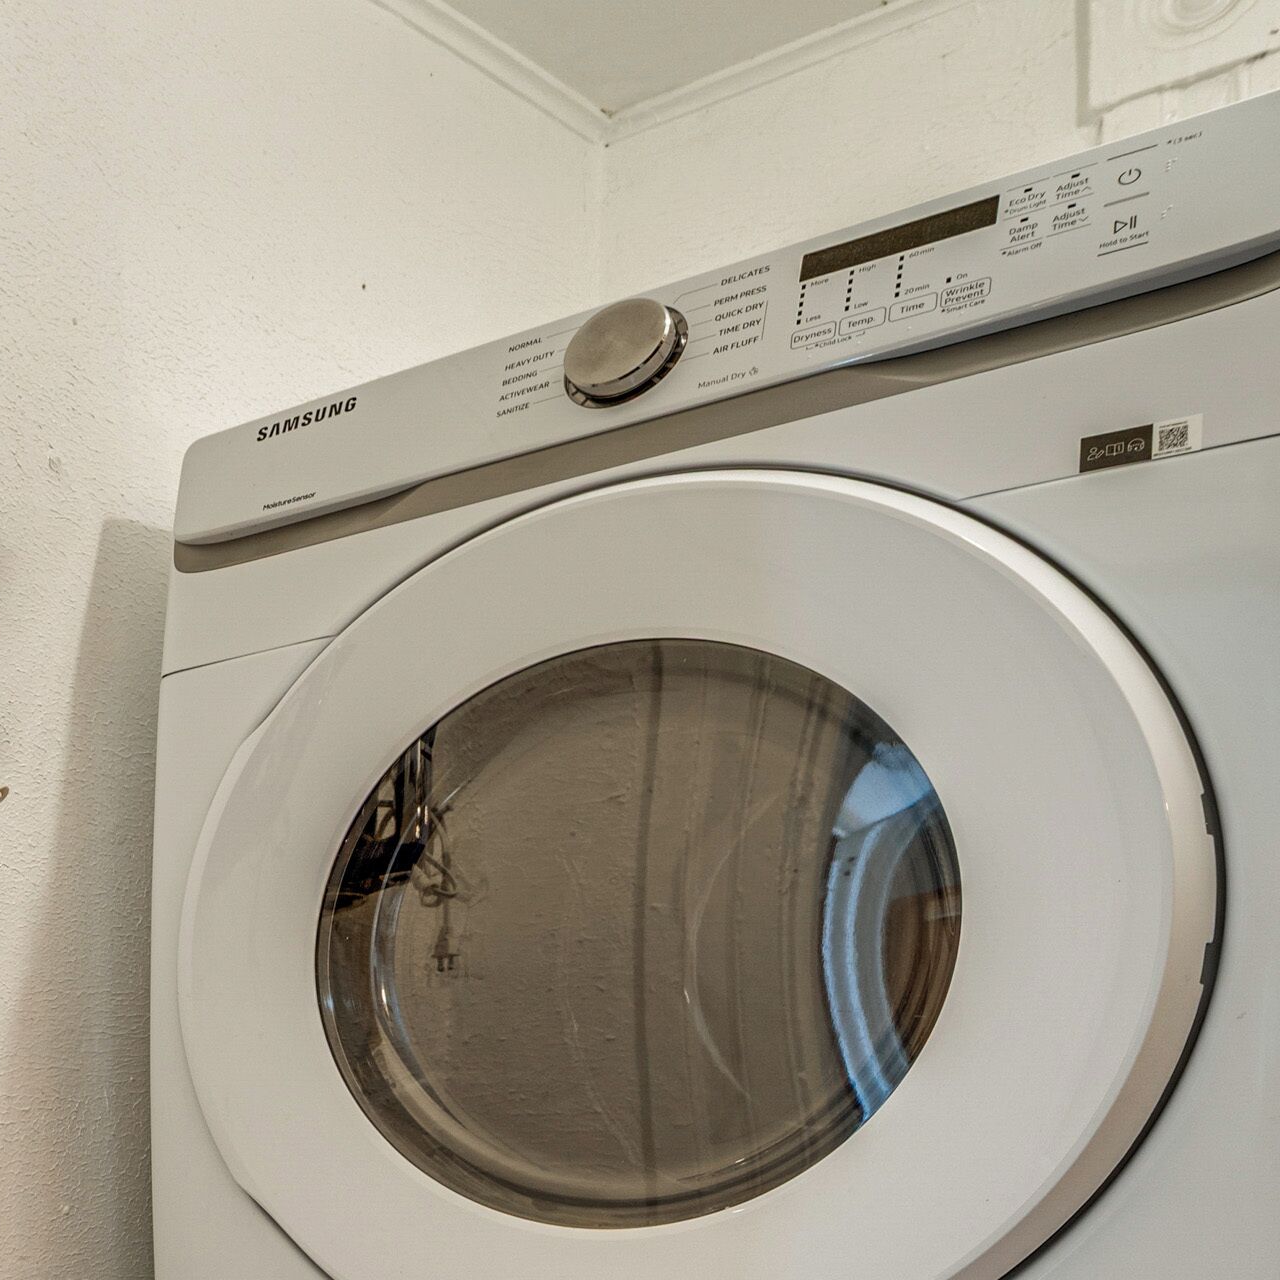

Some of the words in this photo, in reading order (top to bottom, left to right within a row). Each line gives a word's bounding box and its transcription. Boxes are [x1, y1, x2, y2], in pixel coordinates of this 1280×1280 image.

[1056, 177, 1089, 193] Adjust
[1009, 196, 1026, 206] Eco
[1027, 190, 1046, 203] Dry
[1056, 189, 1080, 200] Time
[1052, 208, 1085, 224] Adjust
[1009, 222, 1038, 236] Damp
[1052, 218, 1077, 231] Time
[1010, 231, 1035, 243] Alert
[1099, 238, 1118, 249] Hold
[1119, 235, 1128, 243] to
[1129, 230, 1149, 241] Start
[720, 265, 770, 286] DELICATES
[811, 277, 829, 288] More
[714, 293, 739, 307] PERM
[740, 285, 767, 300] PRESS
[944, 289, 984, 305] Prevent
[946, 281, 985, 297] Wrinkle
[714, 306, 743, 322] QUICK
[744, 301, 764, 315] DRY
[854, 301, 868, 309] Low
[900, 302, 925, 314] Time
[969, 299, 985, 309] Care
[806, 314, 821, 323] Less
[847, 317, 875, 330] Temp.
[719, 324, 741, 337] TIME
[742, 318, 762, 332] DRY
[793, 327, 832, 344] Dryness
[508, 337, 543, 353] NORMAL
[713, 343, 729, 355] AIR
[732, 336, 759, 351] FLUFF
[505, 357, 532, 372] HEAVY
[533, 351, 555, 365] DUTY
[502, 370, 538, 387] BEDDING
[698, 373, 728, 390] Manual
[730, 370, 746, 385] Dry
[499, 381, 550, 402] ACTIVEWEAR
[496, 403, 530, 418] SANITIZE
[256, 397, 357, 442] SAMSUNG
